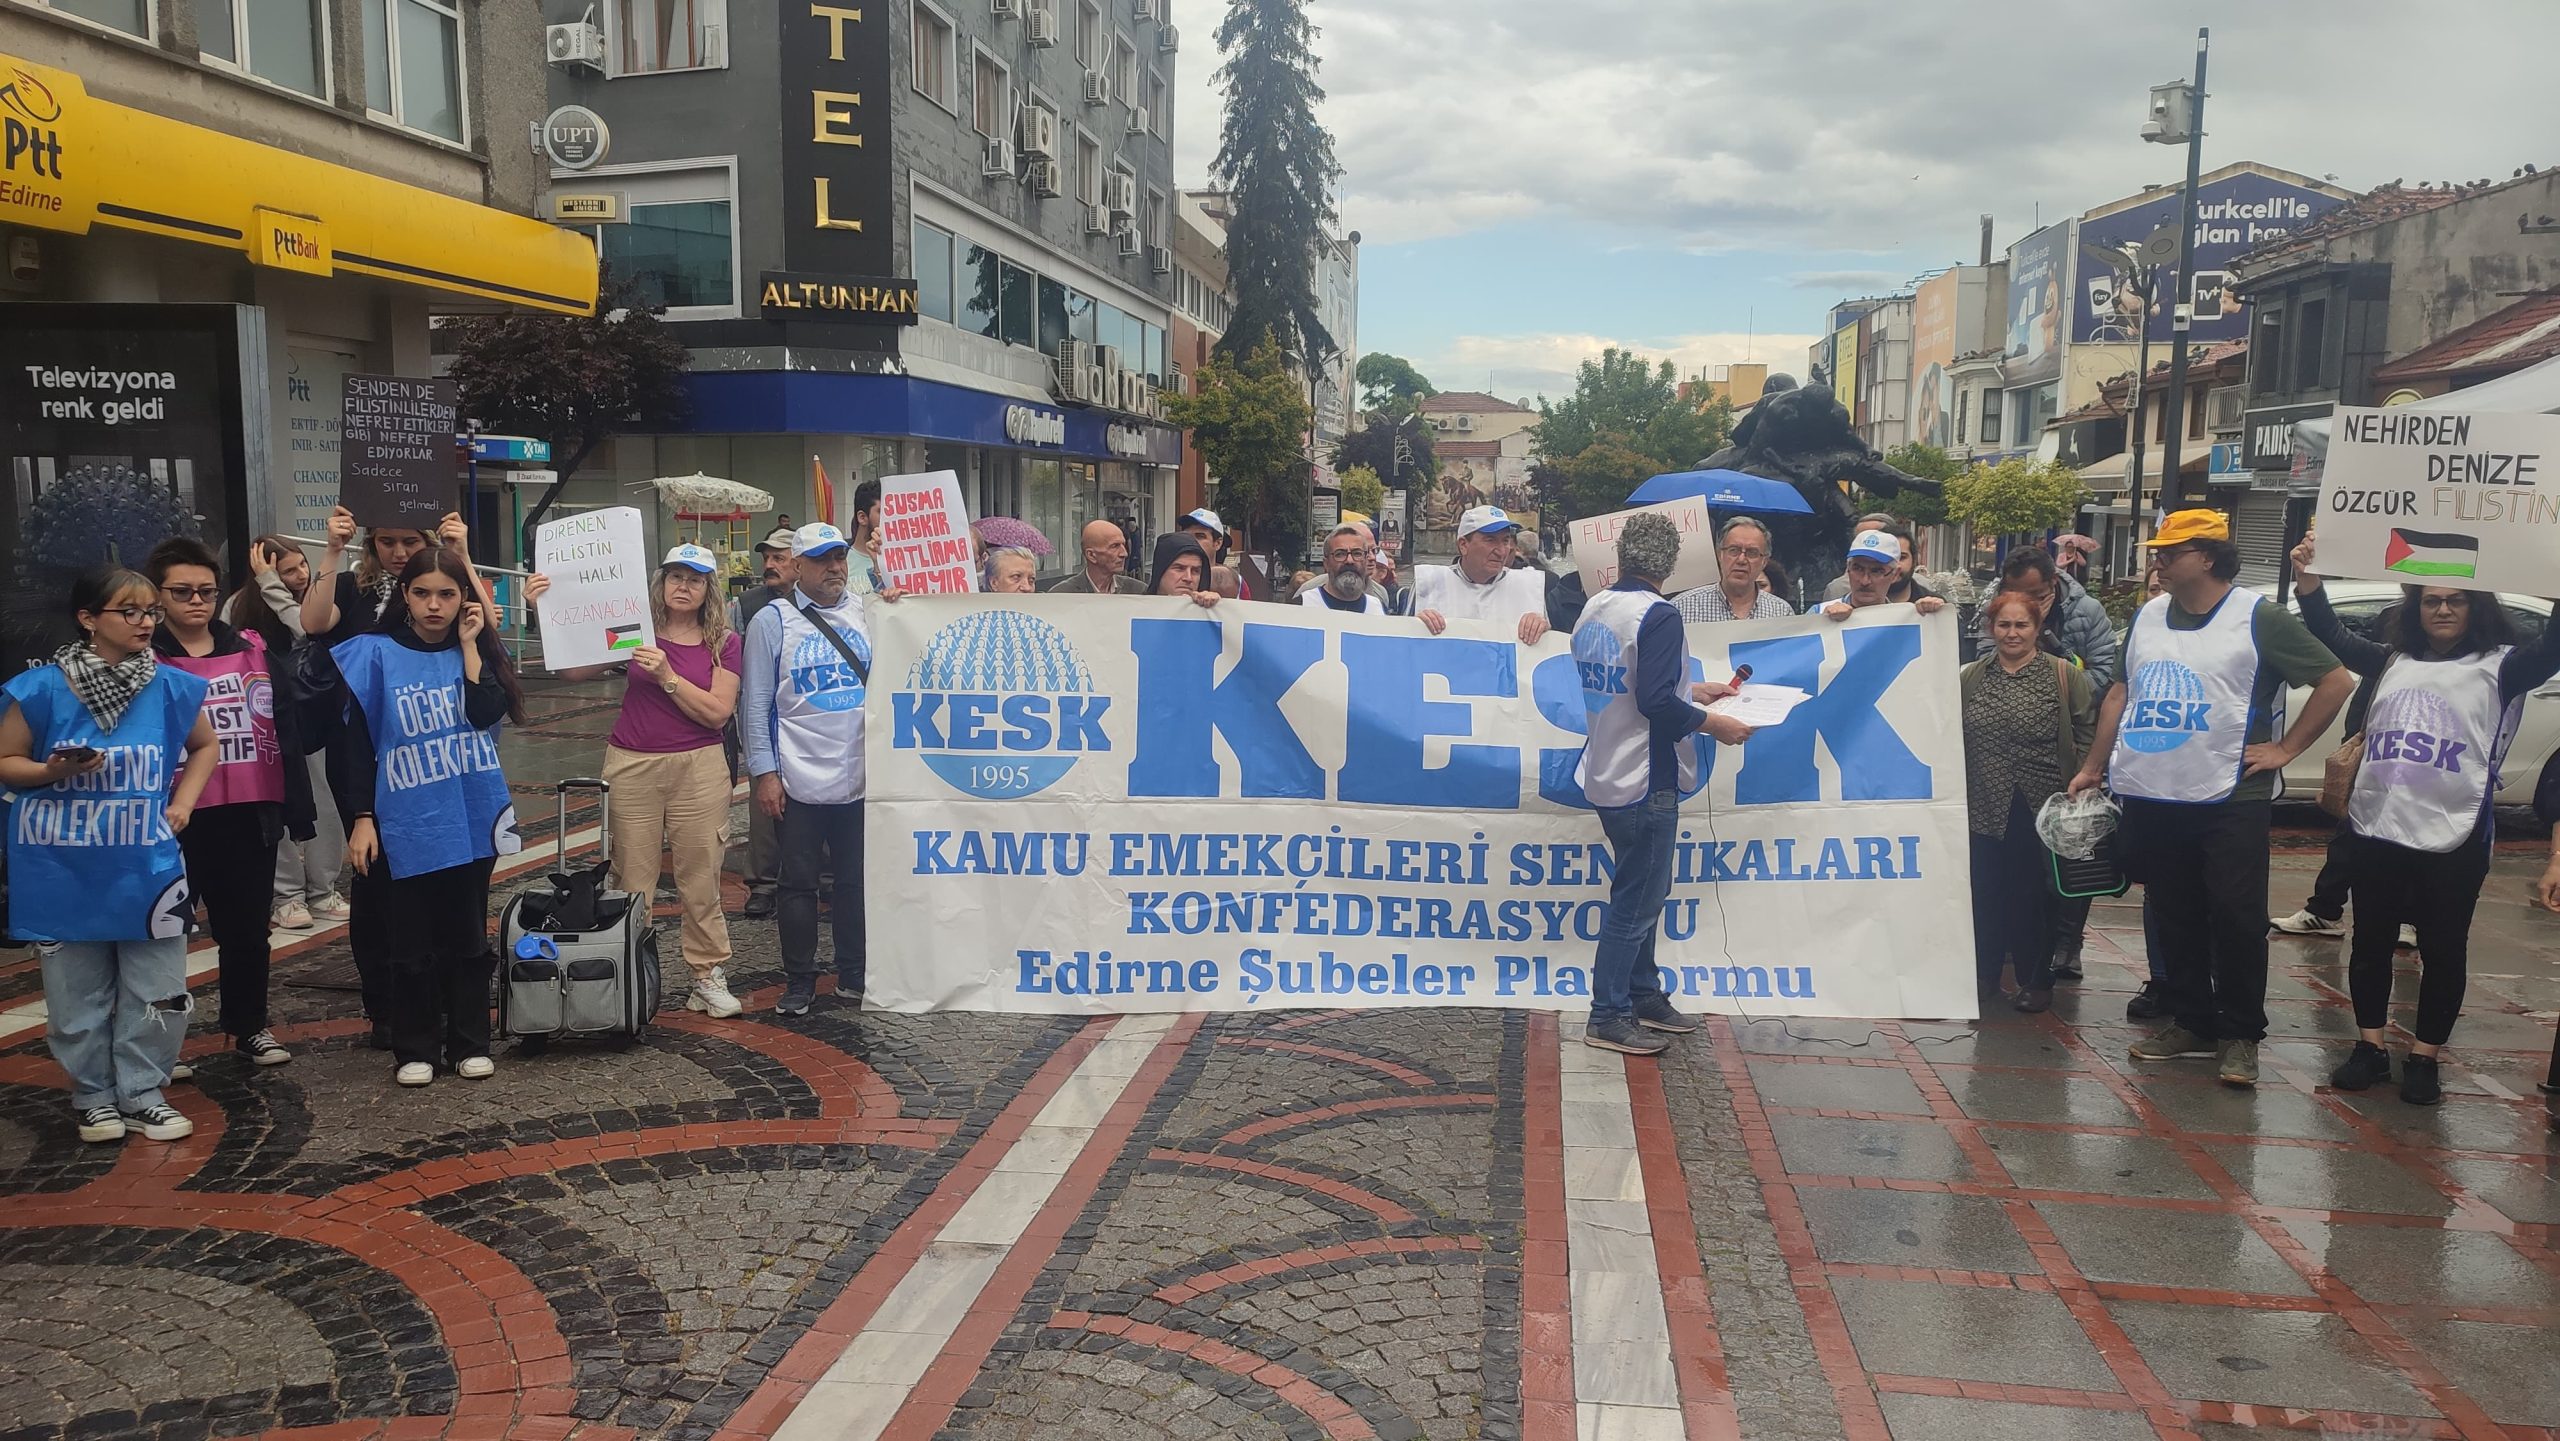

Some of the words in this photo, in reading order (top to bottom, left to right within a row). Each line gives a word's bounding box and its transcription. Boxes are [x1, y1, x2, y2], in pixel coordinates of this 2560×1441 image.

[5, 116, 63, 181] Ptt
[552, 127, 595, 143] UPT
[0, 180, 63, 212] Edirne
[274, 227, 320, 261] PttBank
[760, 281, 919, 314] ALTUNHAN
[25, 365, 177, 394] Televizyona
[288, 376, 311, 402] Ptt
[347, 377, 411, 398] SENDEN
[416, 384, 435, 401] DE
[41, 396, 95, 419] renk
[102, 397, 165, 425] geldi
[345, 413, 402, 431] NEFRET
[380, 430, 432, 447] NEFRET
[2254, 417, 2295, 460] PADİŞ
[2343, 413, 2472, 447] NEHİRDEN
[293, 470, 340, 484] CHANGE
[351, 462, 404, 478] Sadece
[2427, 450, 2541, 486] DENİZE
[883, 487, 945, 517] SUSMA
[2332, 485, 2419, 516] ÖZGÜR
[883, 511, 951, 542] HAYKIR
[884, 536, 970, 573] KATLİAMA
[578, 562, 624, 585] HALKI
[892, 566, 970, 595] HAYIR
[550, 594, 643, 628] KAZANACAK
[790, 660, 871, 694] KES
[1577, 660, 1629, 694] ESK
[827, 693, 857, 708] 1995
[207, 705, 244, 730] İST
[891, 691, 1113, 752] KESK
[2138, 735, 2167, 749] 1995
[2366, 729, 2468, 773] KESK
[968, 764, 1031, 790] 1995
[911, 830, 1091, 877] KAMU
[1108, 824, 1490, 889] EMEKÇİLERİ
[1509, 830, 1923, 887] SENİKALARI
[1126, 891, 1700, 943] KONFEDERASYOU
[1015, 949, 1219, 996] Edirne
[1239, 947, 1476, 1004] Şubeler
[1493, 954, 1816, 1000] Plaormu
